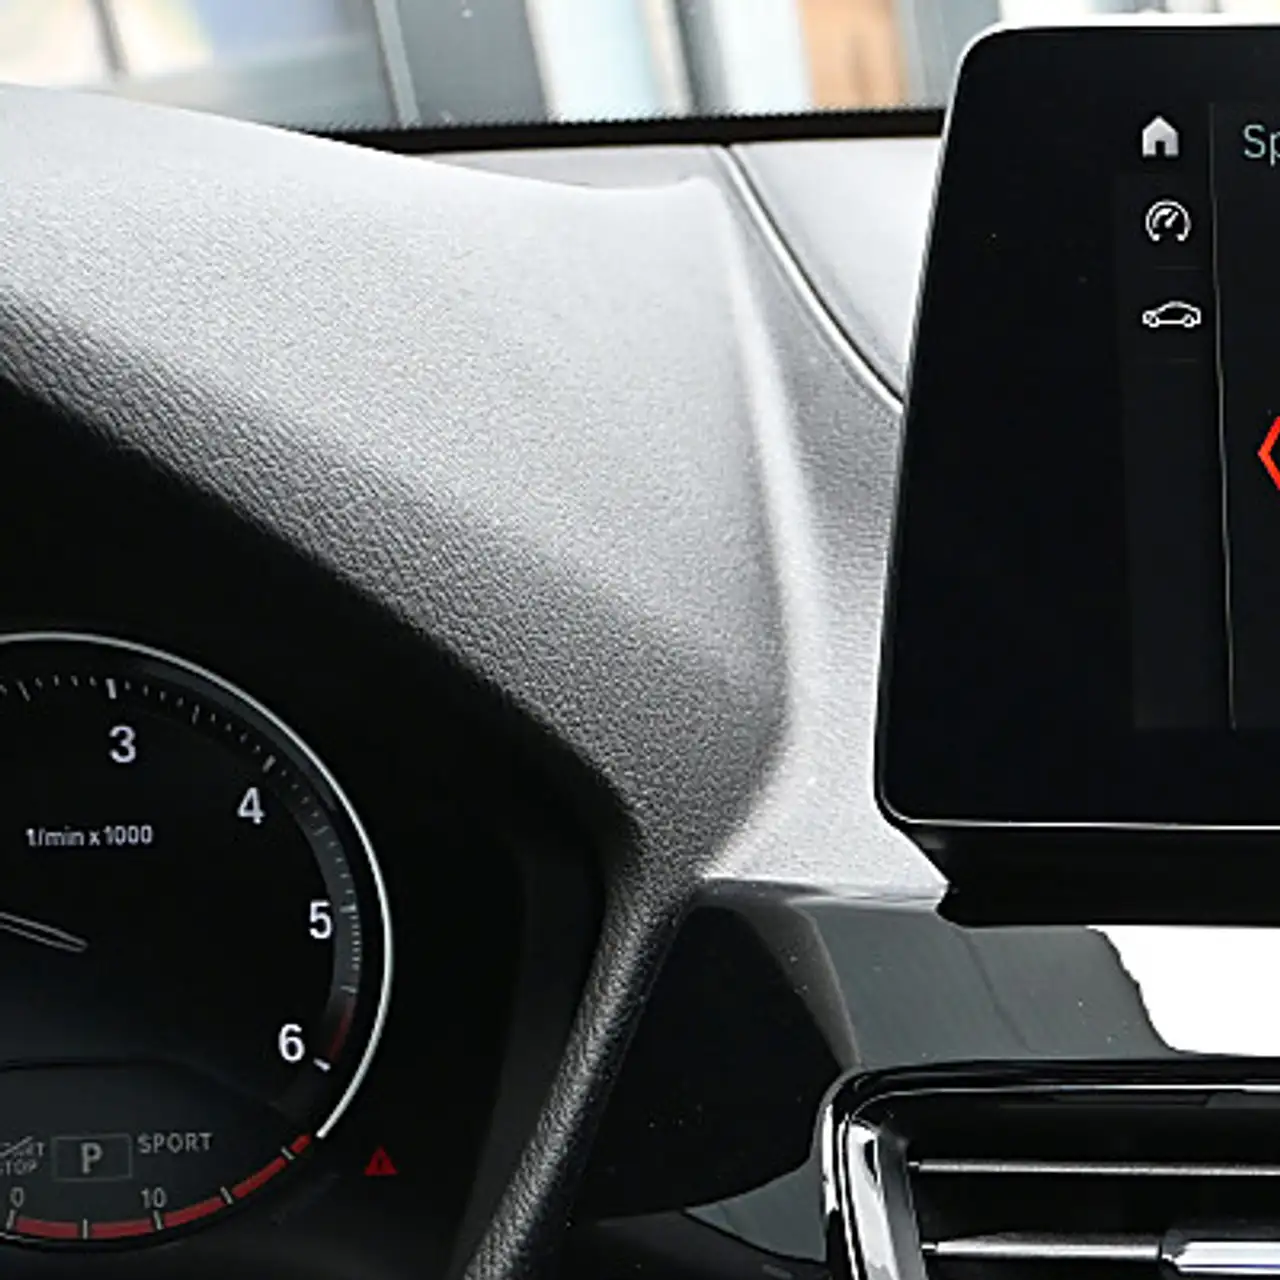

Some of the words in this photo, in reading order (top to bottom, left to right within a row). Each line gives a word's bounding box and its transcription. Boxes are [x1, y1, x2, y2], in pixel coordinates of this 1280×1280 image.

[109, 726, 136, 764] 3
[237, 787, 265, 824] 4
[26, 826, 84, 847] 1/min
[88, 830, 100, 846] x
[105, 825, 153, 845] 1000
[309, 900, 333, 939] 5
[278, 1024, 305, 1062] 6
[138, 1133, 213, 1153] SPORT
[81, 1144, 104, 1174] P
[11, 1188, 25, 1207] 0
[141, 1187, 166, 1207] 10
